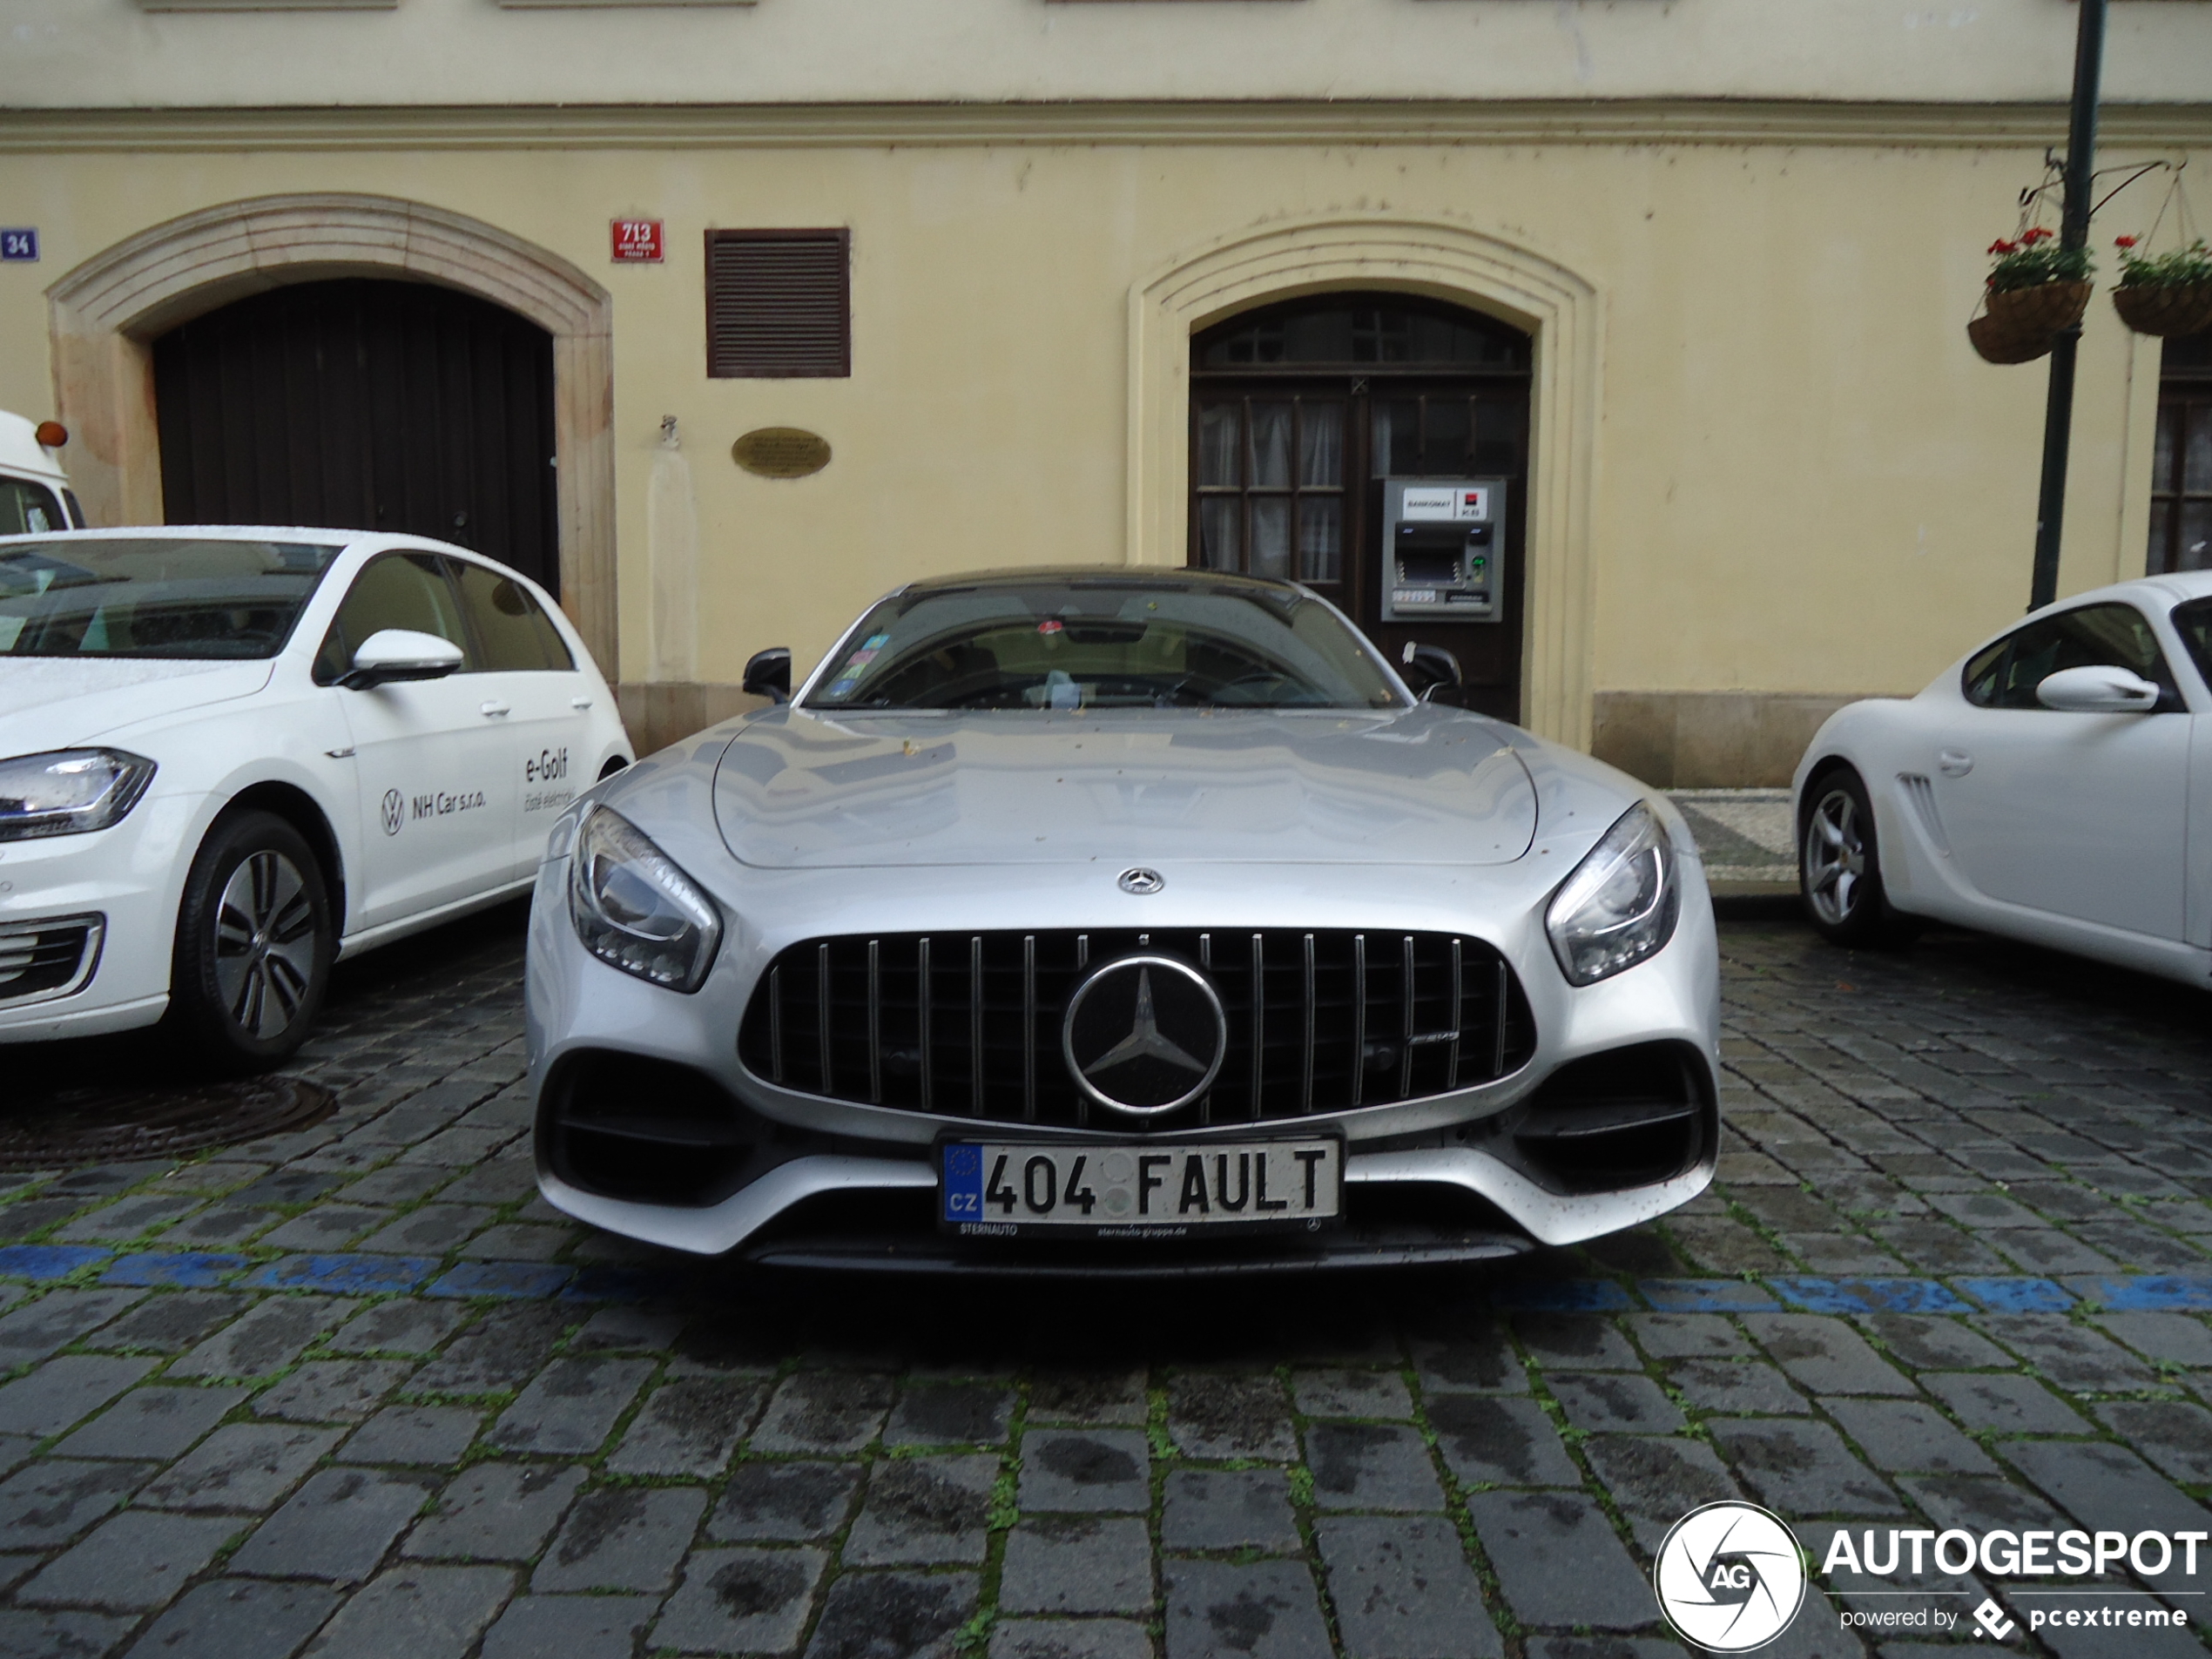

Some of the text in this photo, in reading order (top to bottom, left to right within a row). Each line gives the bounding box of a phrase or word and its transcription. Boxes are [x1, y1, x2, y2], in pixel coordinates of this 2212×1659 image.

[622, 223, 651, 241] 713
[8, 235, 29, 253] 34
[527, 747, 567, 782] e-Golf
[412, 790, 487, 820] NH Car s.r.o.
[986, 1150, 1327, 1215] 404 FAULT
[949, 1192, 978, 1212] CZ
[960, 1223, 1018, 1237] STERNAUTO
